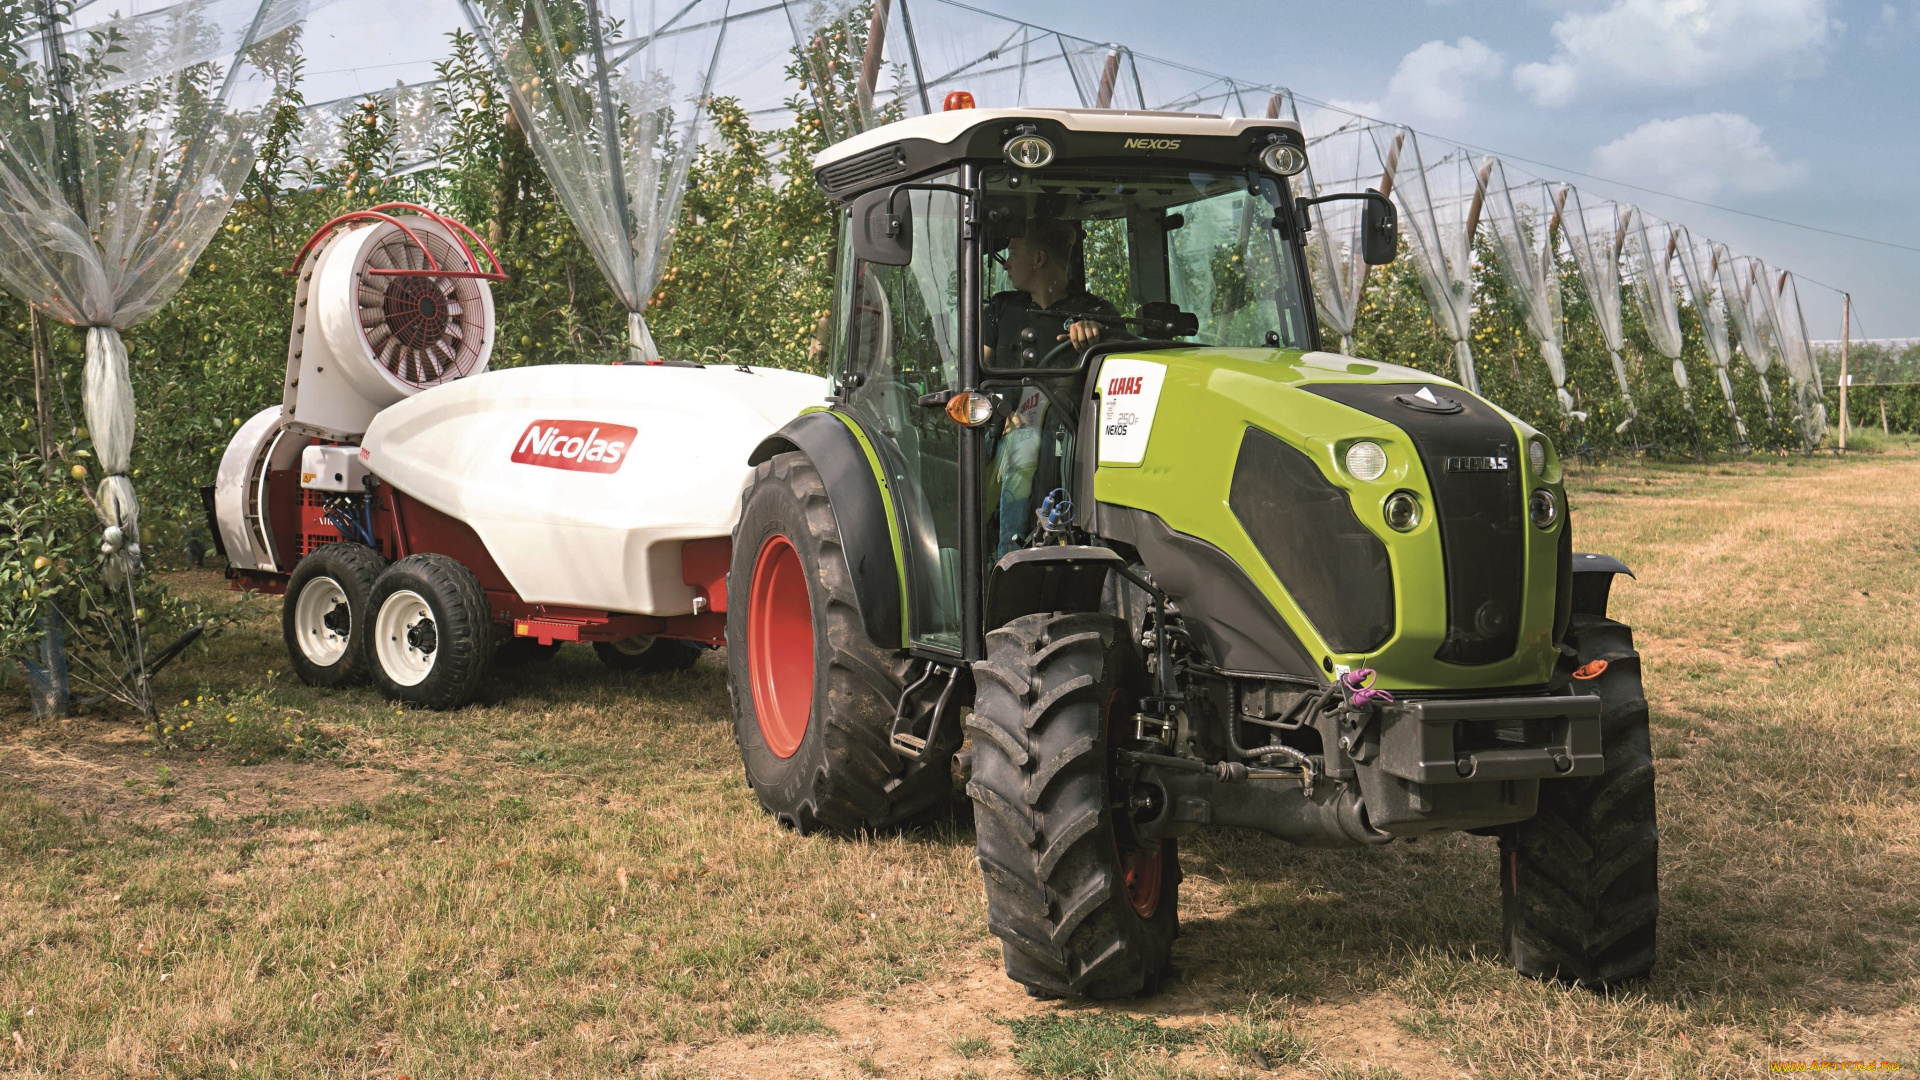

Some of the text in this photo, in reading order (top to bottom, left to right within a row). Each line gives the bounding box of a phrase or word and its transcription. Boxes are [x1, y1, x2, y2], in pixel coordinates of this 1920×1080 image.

[1124, 138, 1181, 149] NEXOS
[1107, 376, 1143, 395] CLAAS
[1105, 424, 1127, 436] NEXOS
[518, 425, 625, 463] Nicolas
